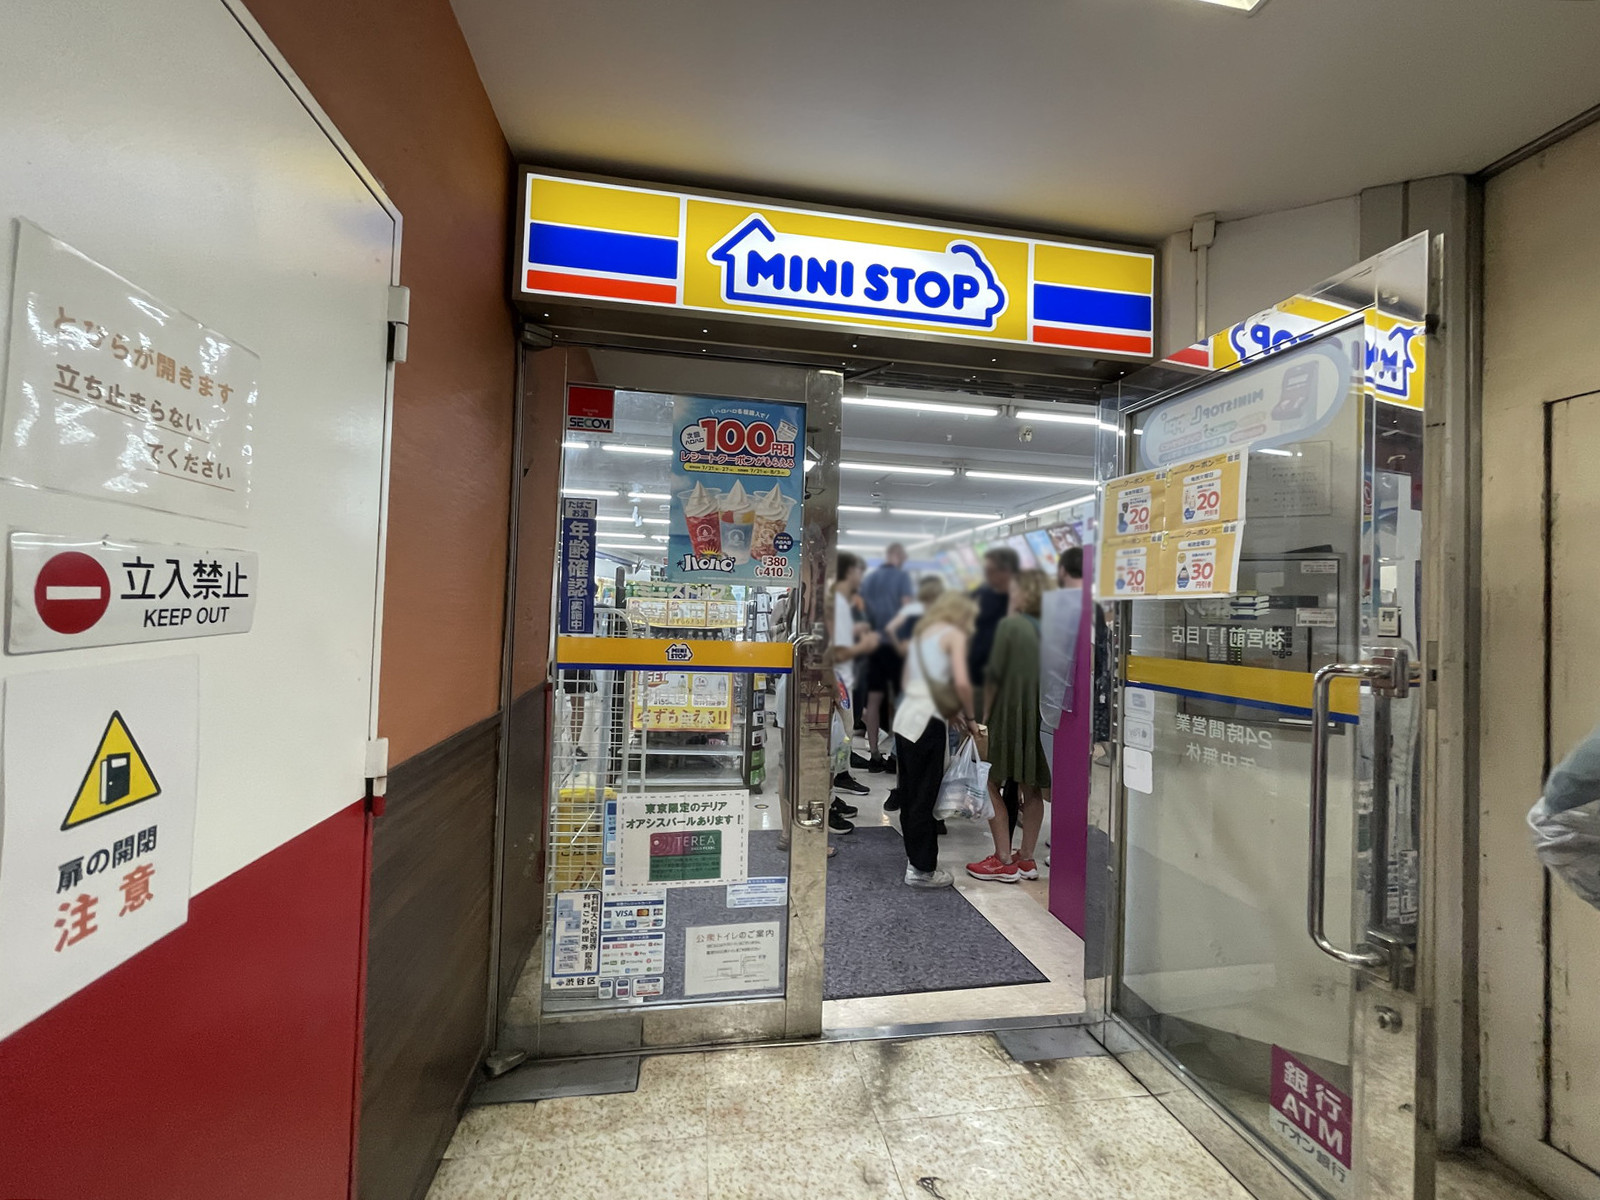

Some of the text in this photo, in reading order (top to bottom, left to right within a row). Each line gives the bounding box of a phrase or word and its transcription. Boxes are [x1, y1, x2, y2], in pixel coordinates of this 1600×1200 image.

[747, 249, 980, 309] MINI STOP
[569, 417, 611, 429] SECOM
[686, 431, 701, 440] 次回
[699, 418, 795, 457] 100 円引
[146, 443, 231, 480] でください
[680, 451, 796, 468] レシートクーポンがもらえる
[1188, 459, 1215, 472] クーポン
[568, 500, 592, 510] たばこ
[1196, 490, 1220, 511] 20
[572, 509, 589, 518] お酒
[1129, 506, 1150, 525] 20
[567, 520, 590, 599] 年齢確認
[120, 555, 249, 601] 立入禁止
[1126, 569, 1145, 586] 20
[1191, 562, 1214, 581] 30
[143, 605, 230, 628] KEEP OUT
[570, 600, 583, 630] 実施中
[644, 801, 729, 815] 東京限定のテリア
[674, 835, 716, 851] TEREA
[56, 824, 158, 895] 扉の開閉
[54, 863, 155, 953] 注意
[615, 909, 634, 918] VISA
[565, 976, 596, 986] 渋谷区
[1283, 1061, 1343, 1122] 銀行
[1282, 1092, 1344, 1156] ATM
[1277, 1119, 1347, 1184] イオン銀行
